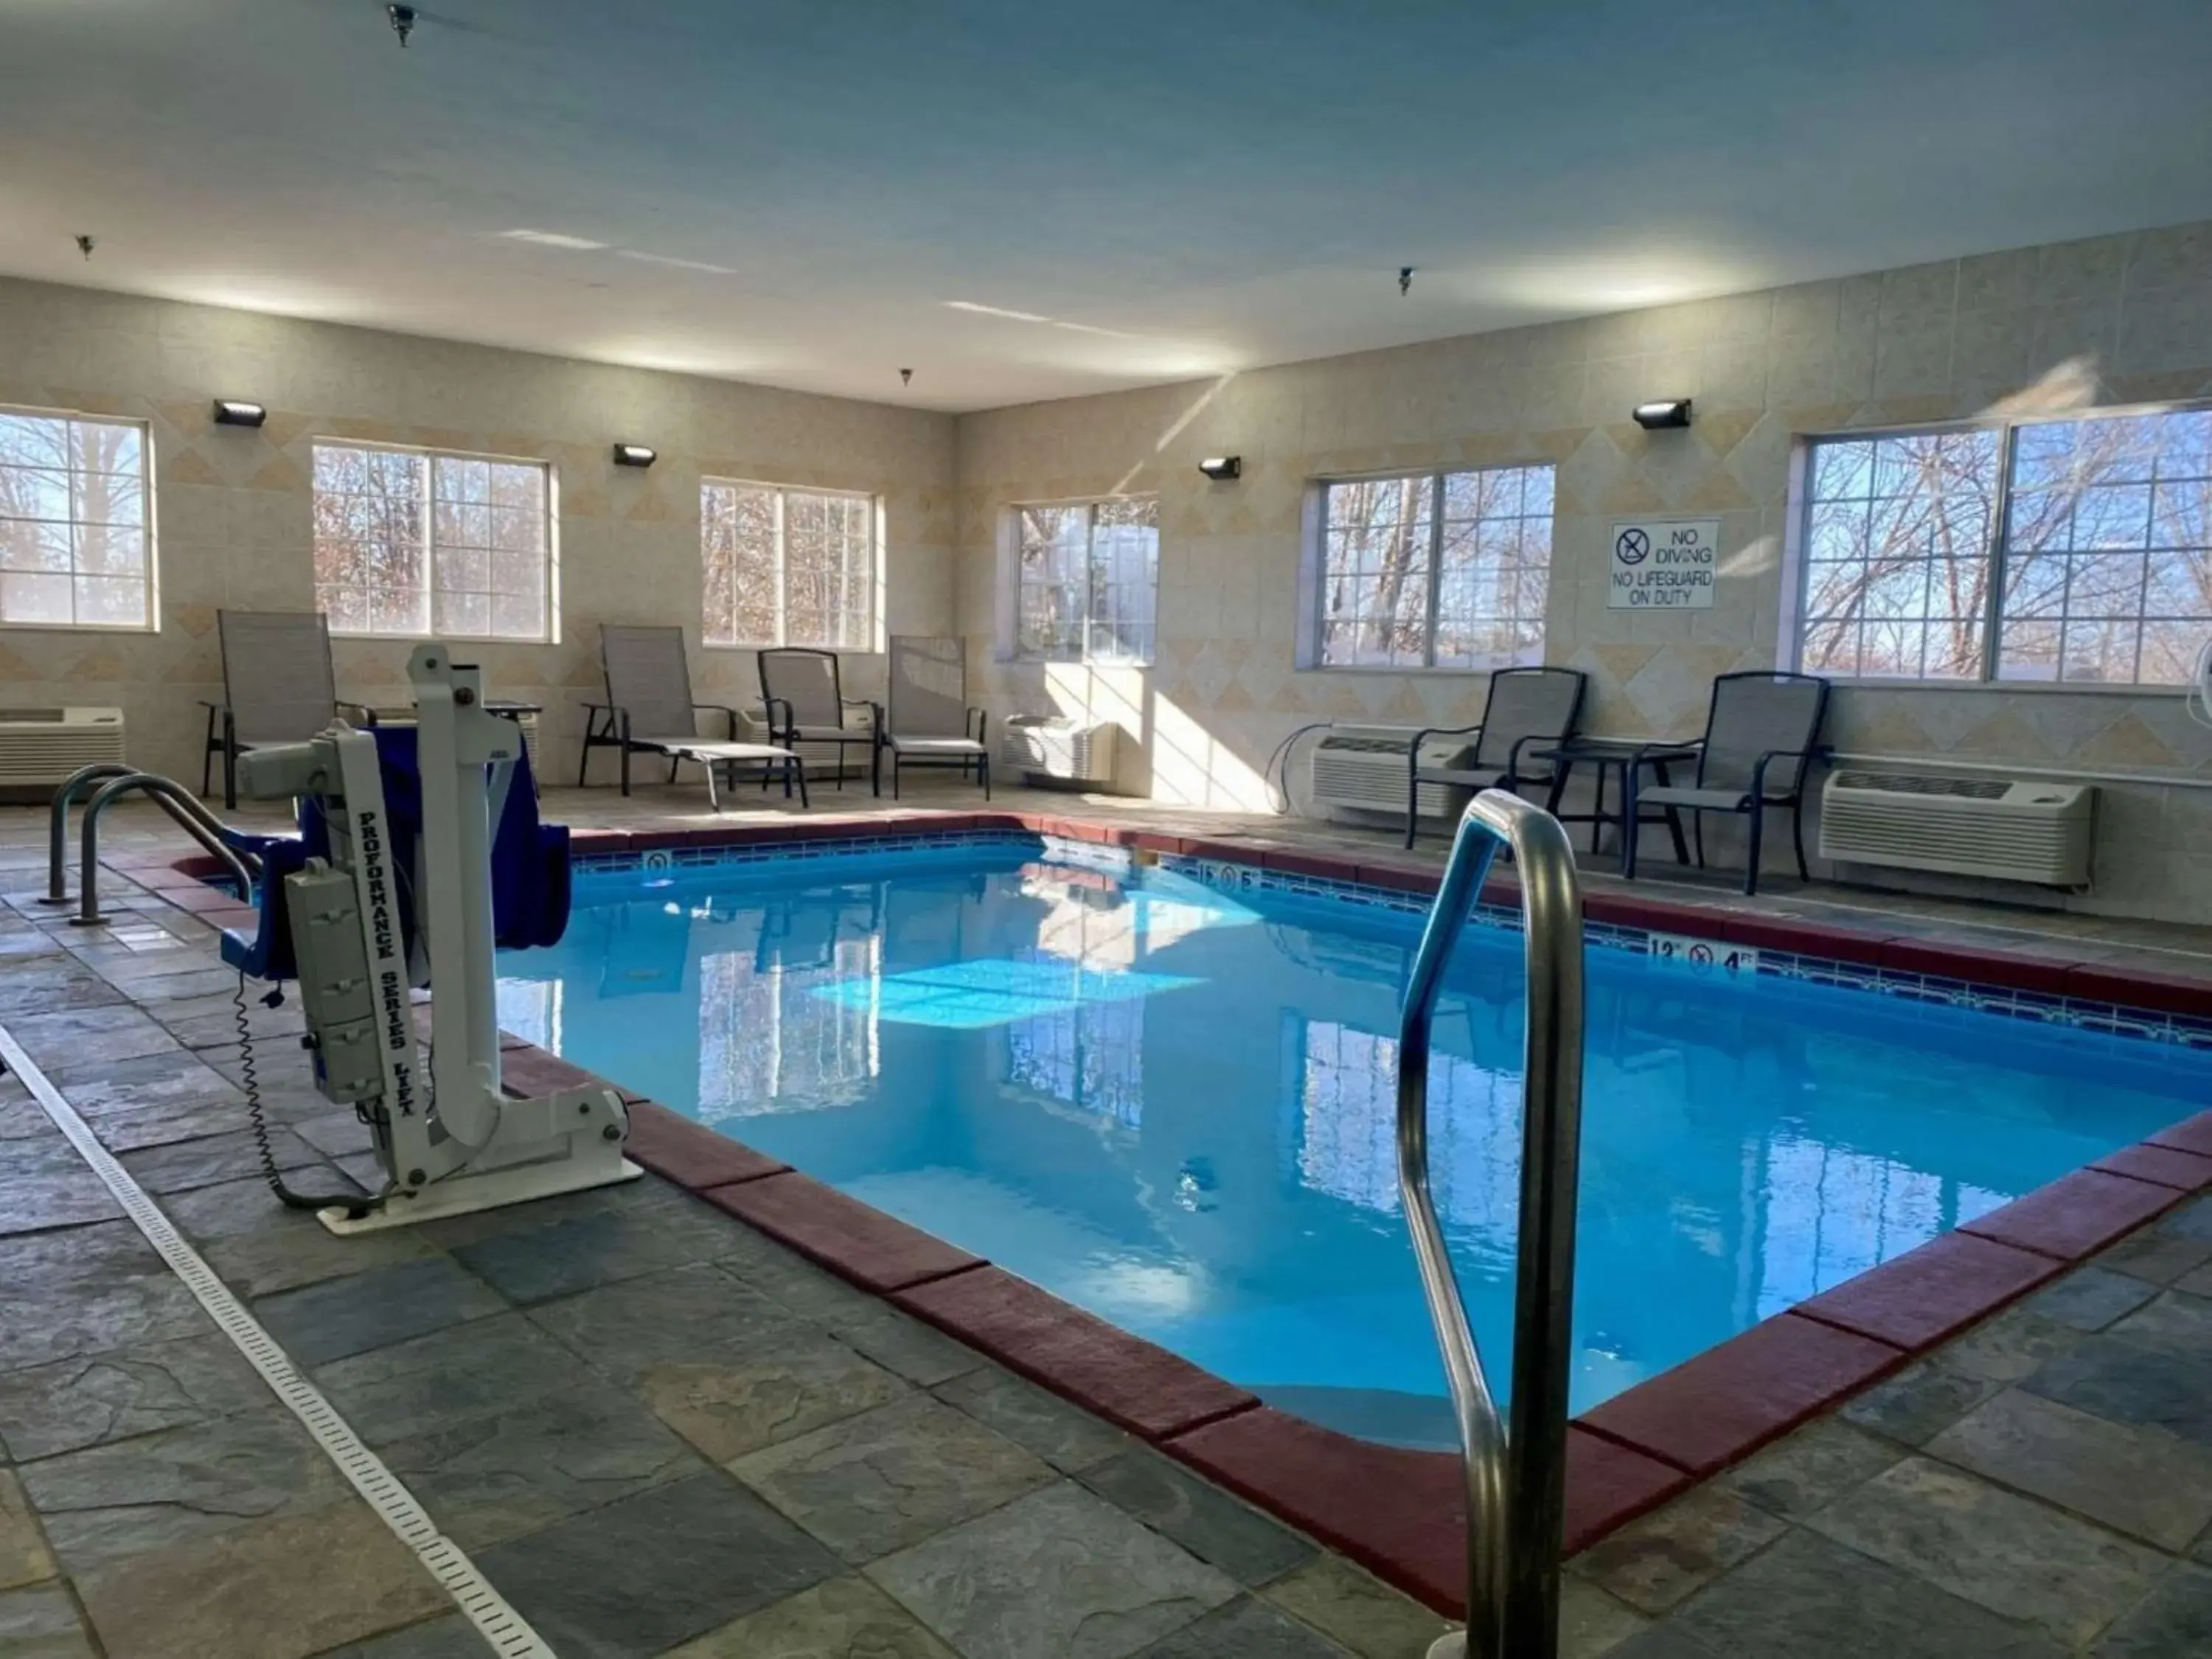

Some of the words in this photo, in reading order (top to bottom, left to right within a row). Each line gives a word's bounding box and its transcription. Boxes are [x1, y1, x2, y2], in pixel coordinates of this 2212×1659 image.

[1672, 529, 1698, 544] NO
[1656, 548, 1712, 564] DIVING
[1613, 572, 1633, 587] NO
[1638, 571, 1713, 586] LIFEGUARD
[1630, 590, 1649, 605] ON
[1655, 590, 1691, 605] DUTY
[359, 812, 394, 959] PROFORMANCE
[380, 971, 406, 1050] SERIES
[393, 1062, 414, 1116] LIFT
